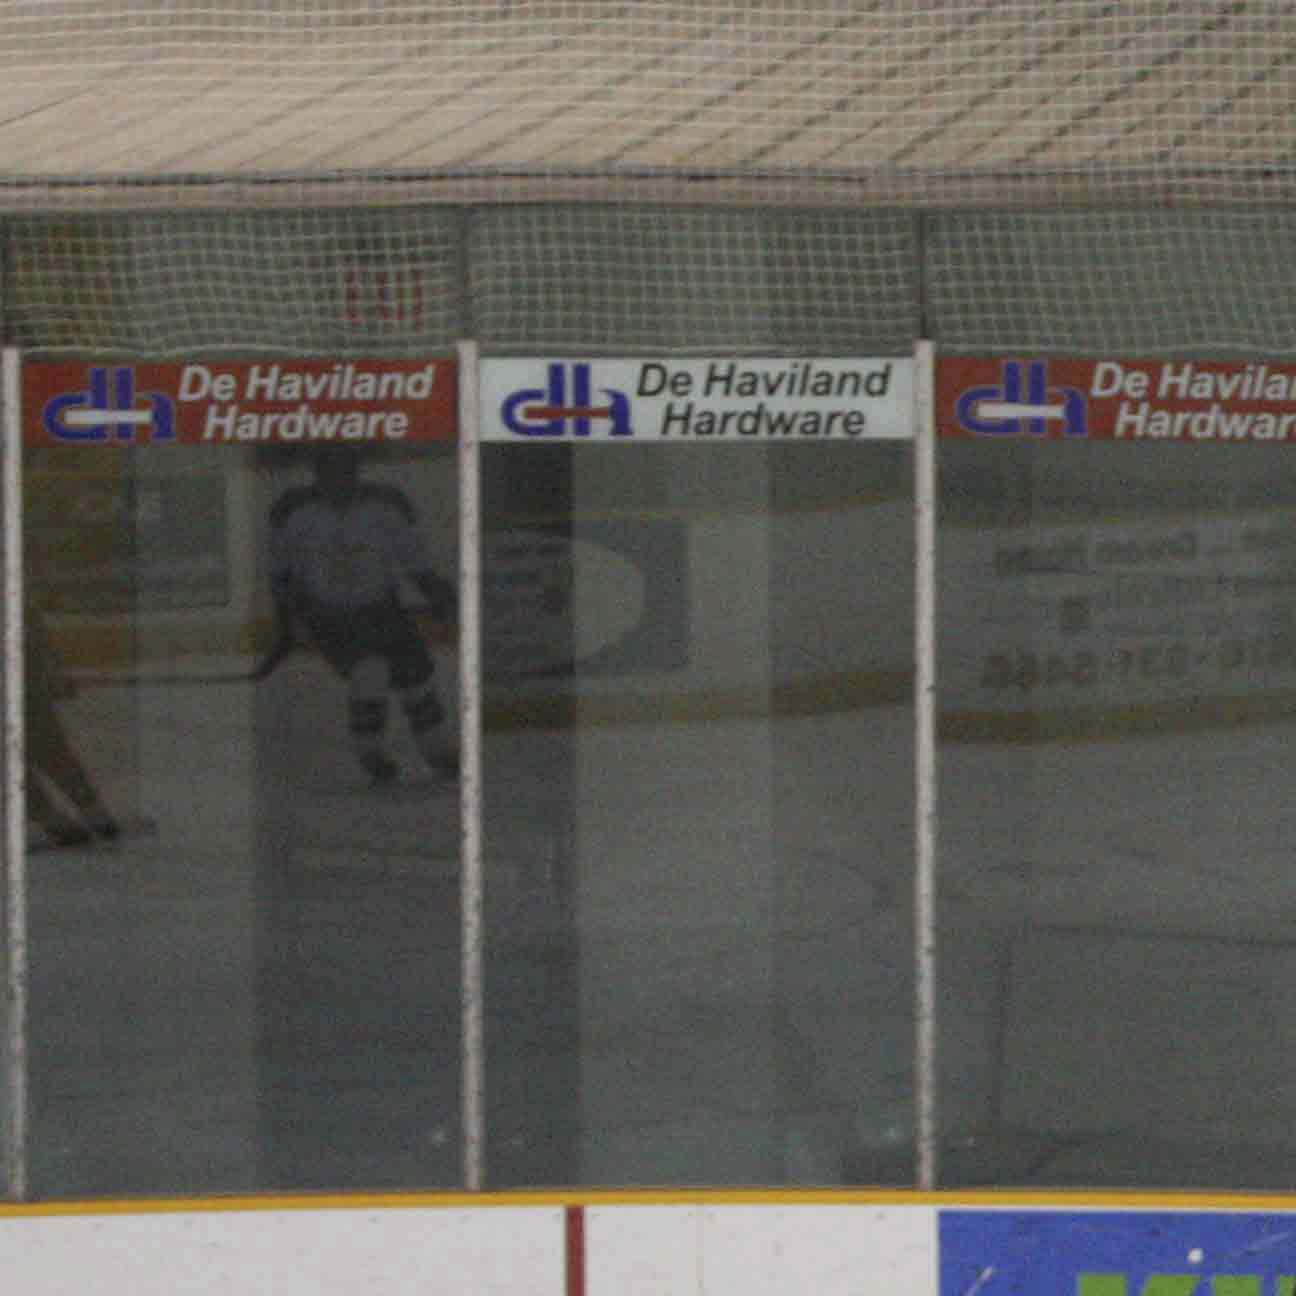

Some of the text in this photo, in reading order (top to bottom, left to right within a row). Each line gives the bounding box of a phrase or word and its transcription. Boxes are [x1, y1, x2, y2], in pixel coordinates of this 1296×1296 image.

[178, 364, 435, 401] De Haviland
[637, 363, 891, 397] De Haviland
[1090, 361, 1148, 398] De
[204, 405, 409, 440] Hardware
[661, 403, 865, 436] Hardware
